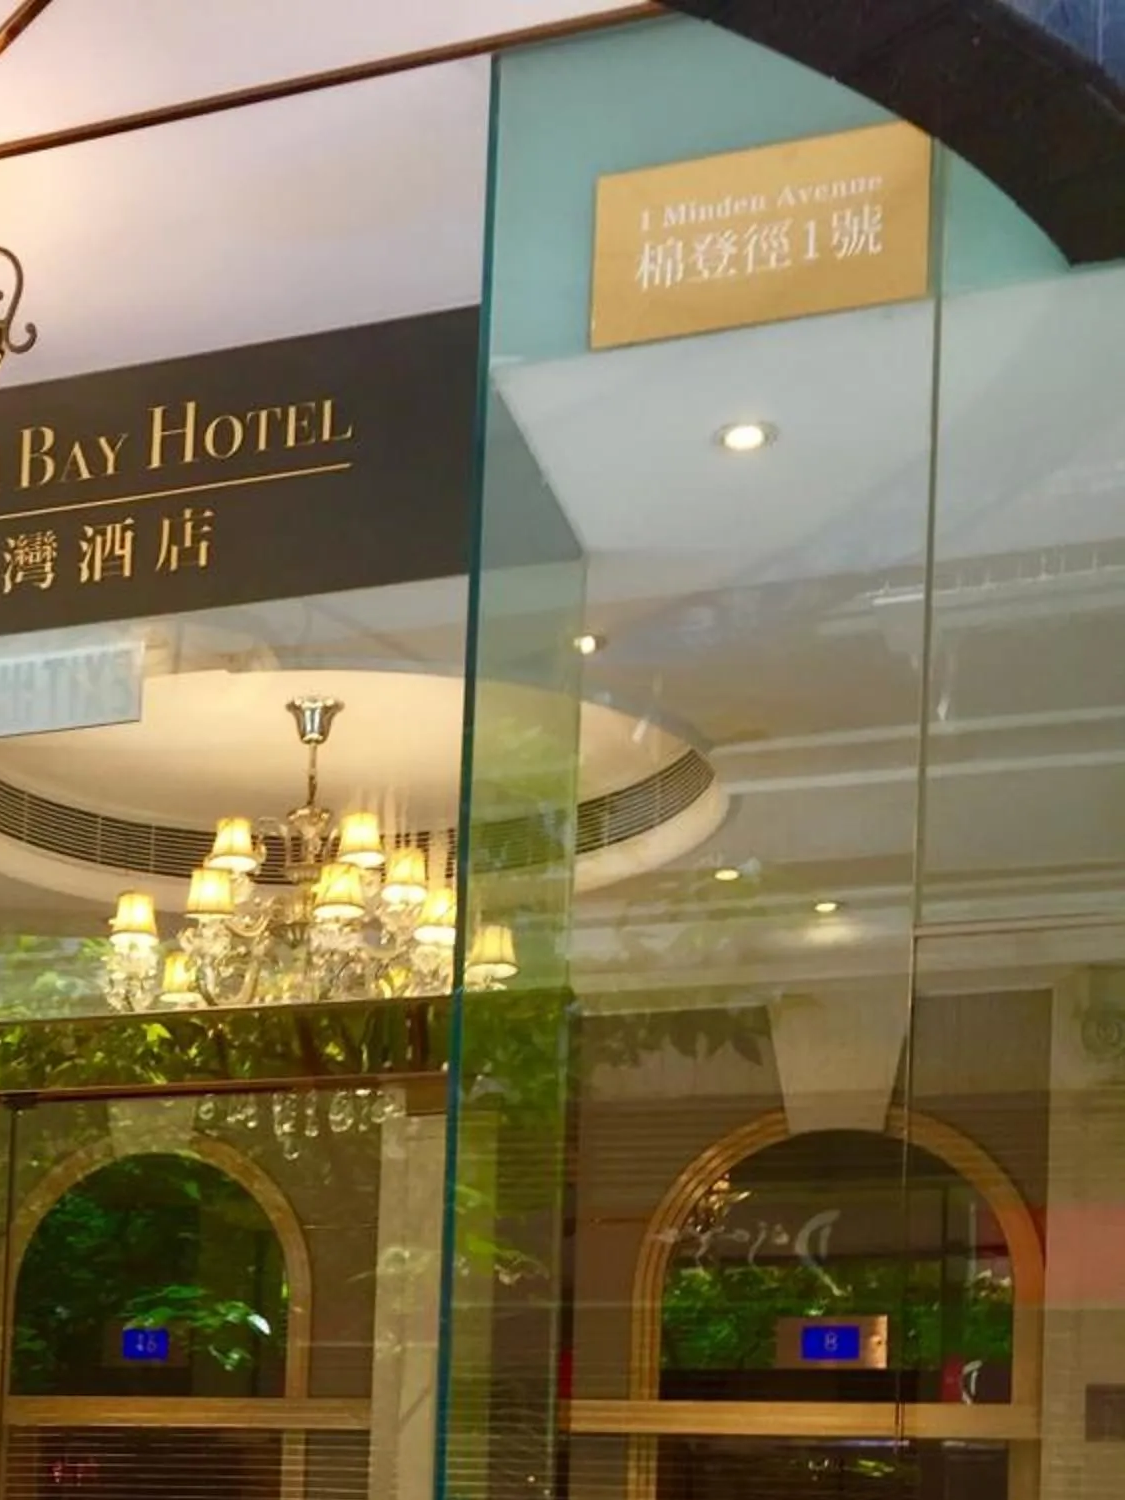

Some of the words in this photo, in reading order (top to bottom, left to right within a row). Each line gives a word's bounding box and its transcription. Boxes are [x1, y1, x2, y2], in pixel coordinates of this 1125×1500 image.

[640, 207, 651, 232] 1
[663, 193, 767, 229] Minden
[777, 175, 883, 208] Avenue
[14, 425, 129, 489] BAY
[146, 399, 354, 470] HOTEL
